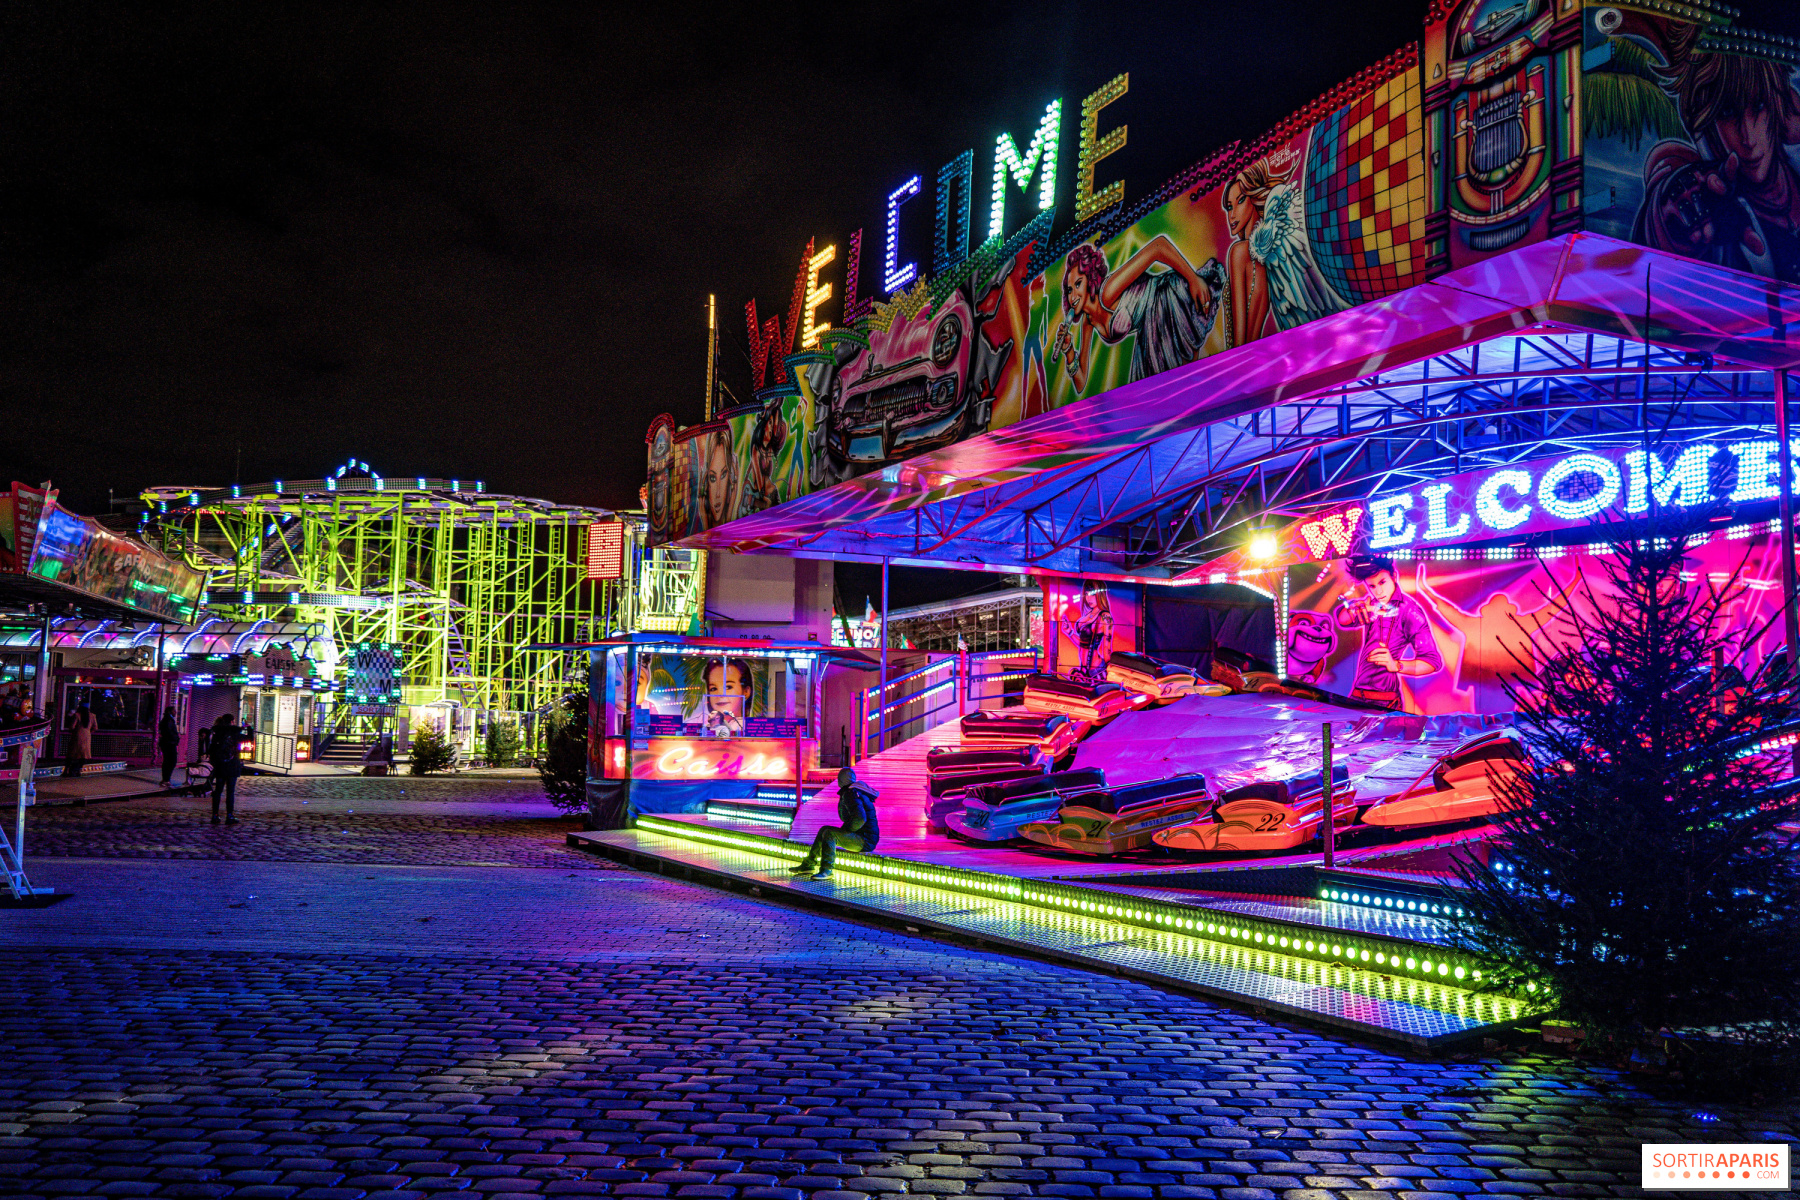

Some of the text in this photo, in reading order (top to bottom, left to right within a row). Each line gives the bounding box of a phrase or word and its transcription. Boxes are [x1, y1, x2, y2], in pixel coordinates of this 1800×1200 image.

[745, 72, 1129, 391] WELCOME
[1297, 437, 1800, 560] WELCOME
[657, 746, 788, 776] Caisse
[1086, 820, 1110, 838] 21
[1140, 817, 1164, 828] RESTEZ
[1254, 812, 1286, 832] 22
